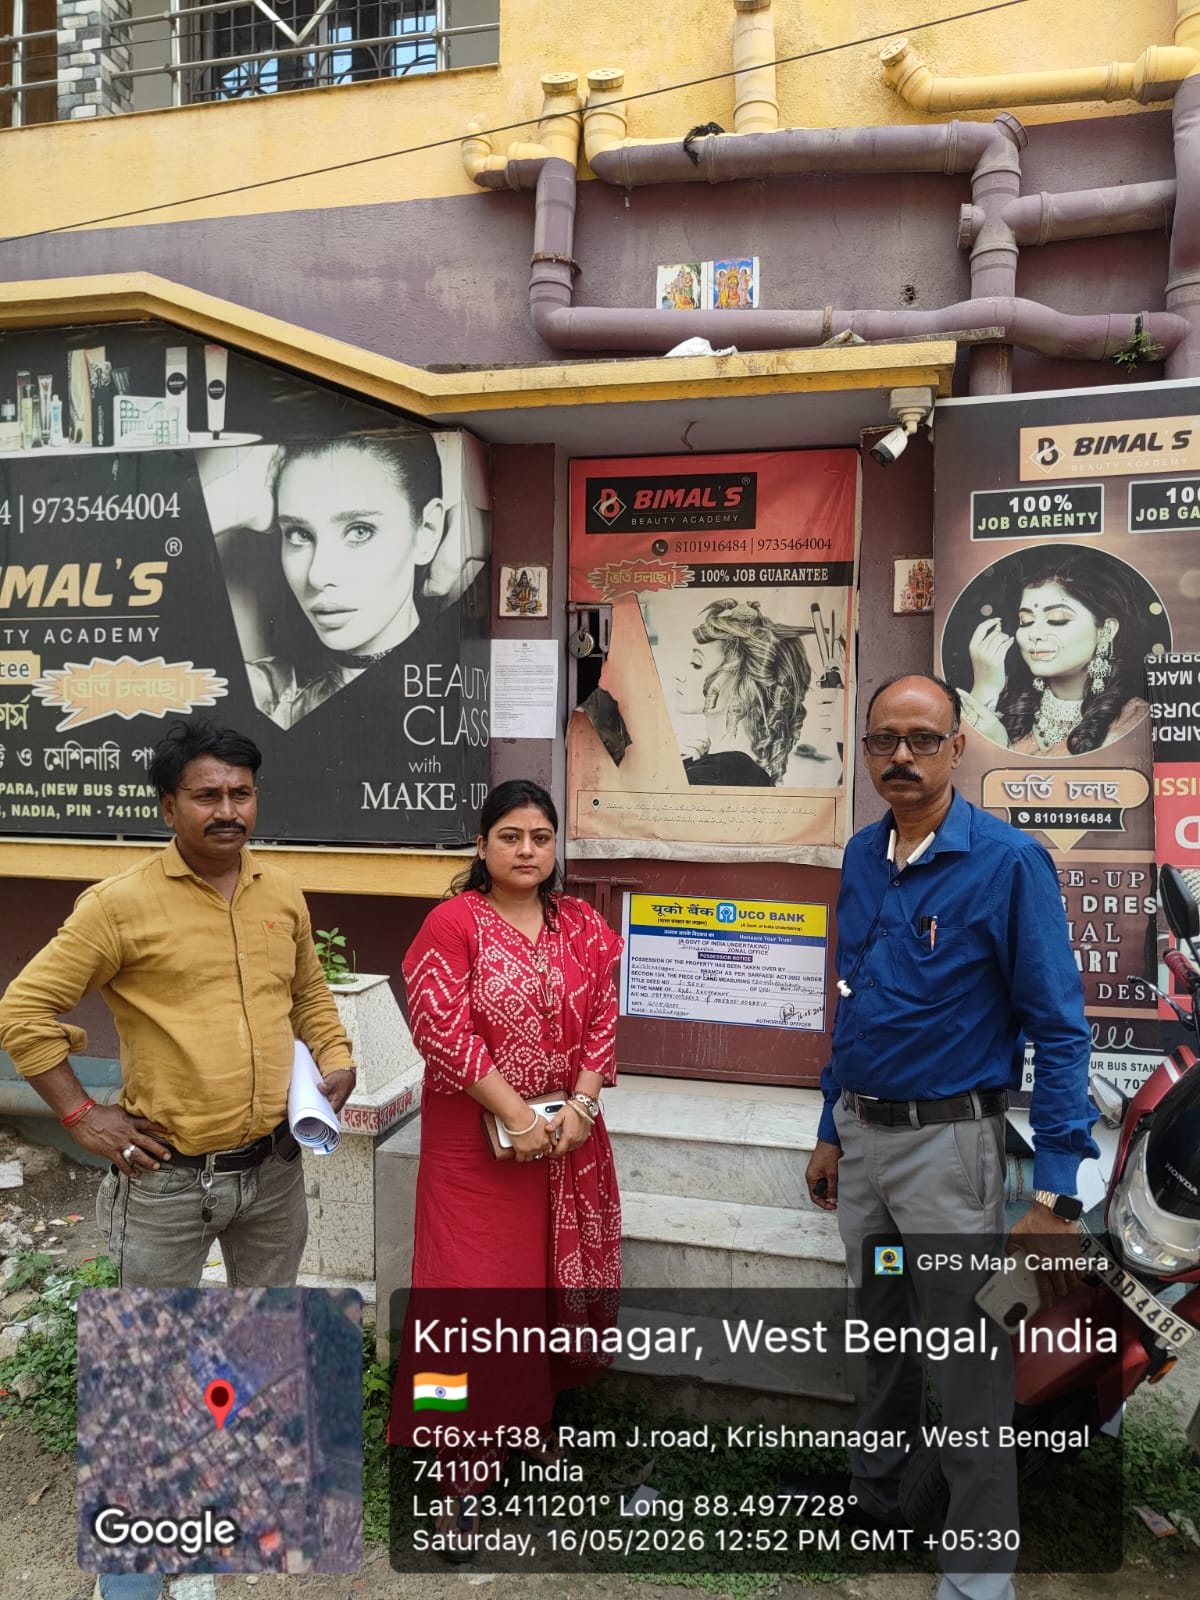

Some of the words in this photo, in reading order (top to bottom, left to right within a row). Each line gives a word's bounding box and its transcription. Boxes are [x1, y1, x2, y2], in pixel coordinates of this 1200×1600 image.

[1073, 429, 1192, 457] BIMAL'S
[1071, 460, 1121, 472] BEAUTY
[1126, 458, 1188, 469] ACADEMY
[633, 485, 744, 510] BIMAL'S
[1008, 493, 1073, 514] 100%
[32, 491, 181, 525] 9735464004
[1135, 507, 1170, 522] JOB
[631, 516, 676, 526] BEAUTY
[682, 514, 739, 524] ACADEMY
[977, 514, 1010, 531] JOB
[1017, 512, 1098, 530] GARENTY
[675, 539, 747, 553] 8101916484
[757, 537, 832, 551] 9735464004
[0, 557, 168, 609] MAL'S
[700, 569, 730, 583] 100%
[733, 569, 756, 582] JOB
[760, 568, 829, 582] GUARANTEE
[43, 627, 160, 645] ACADEMY
[404, 663, 490, 701] BEAUTY
[403, 705, 490, 747] CLASS
[43, 740, 122, 771] মেশিনারি
[408, 754, 441, 774] with
[41, 783, 78, 798] (NEW
[83, 784, 113, 797] BUS
[360, 782, 457, 811] MAKE
[470, 783, 489, 810] UP
[1003, 773, 1055, 802] ভর্তি
[11, 804, 60, 819] NADIA,
[66, 804, 91, 817] PIN
[106, 805, 158, 818] 741101
[1034, 813, 1112, 824] 8101916484
[651, 902, 684, 917] यूको
[686, 903, 714, 917] बैंक
[738, 910, 766, 920] UCO
[769, 912, 806, 923] BANK
[1107, 1062, 1128, 1072] BUS
[1130, 1063, 1159, 1073] STAN
[1165, 1162, 1198, 1196] HONDA
